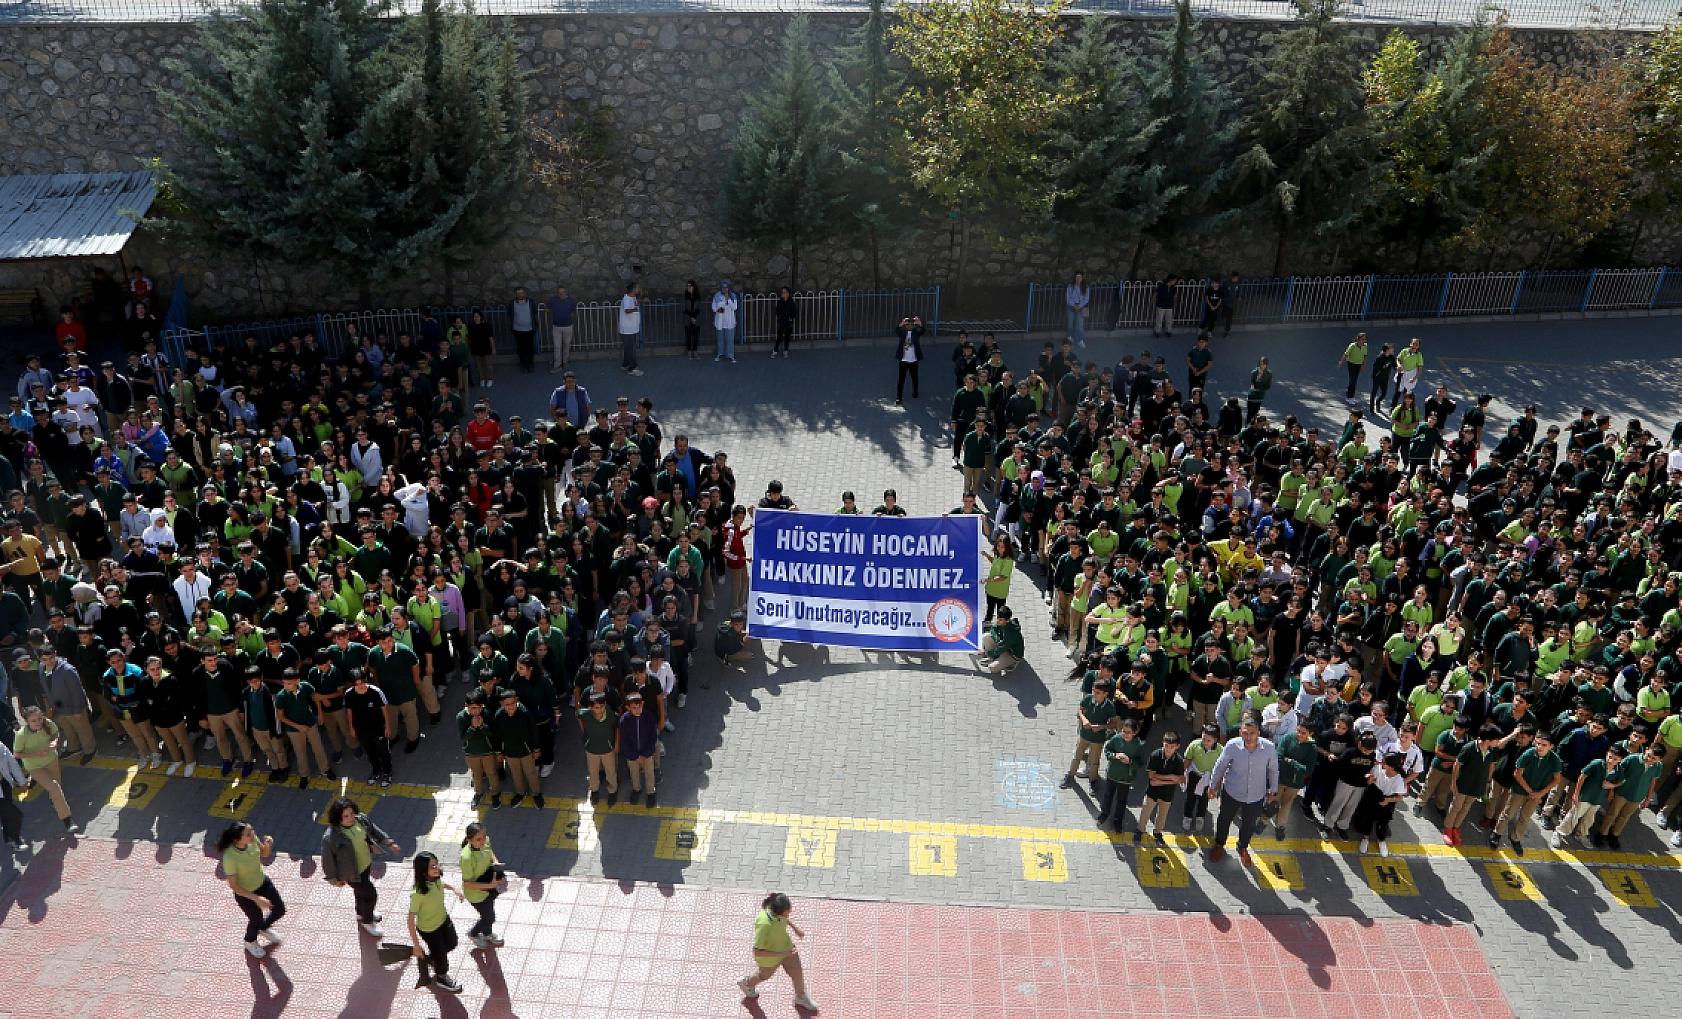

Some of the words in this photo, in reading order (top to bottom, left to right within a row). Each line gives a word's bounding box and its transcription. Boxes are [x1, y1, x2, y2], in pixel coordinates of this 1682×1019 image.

[776, 525, 865, 555] HÜSEYİN
[872, 533, 955, 560] HOCAM,
[759, 558, 857, 588] HAKKINIZ
[862, 561, 970, 589] ÖDENMEZ.
[755, 596, 790, 619] Seni
[794, 600, 927, 630] Unutmayacağız...
[924, 844, 942, 863] L
[1036, 852, 1054, 869] K
[1375, 865, 1401, 884] H
